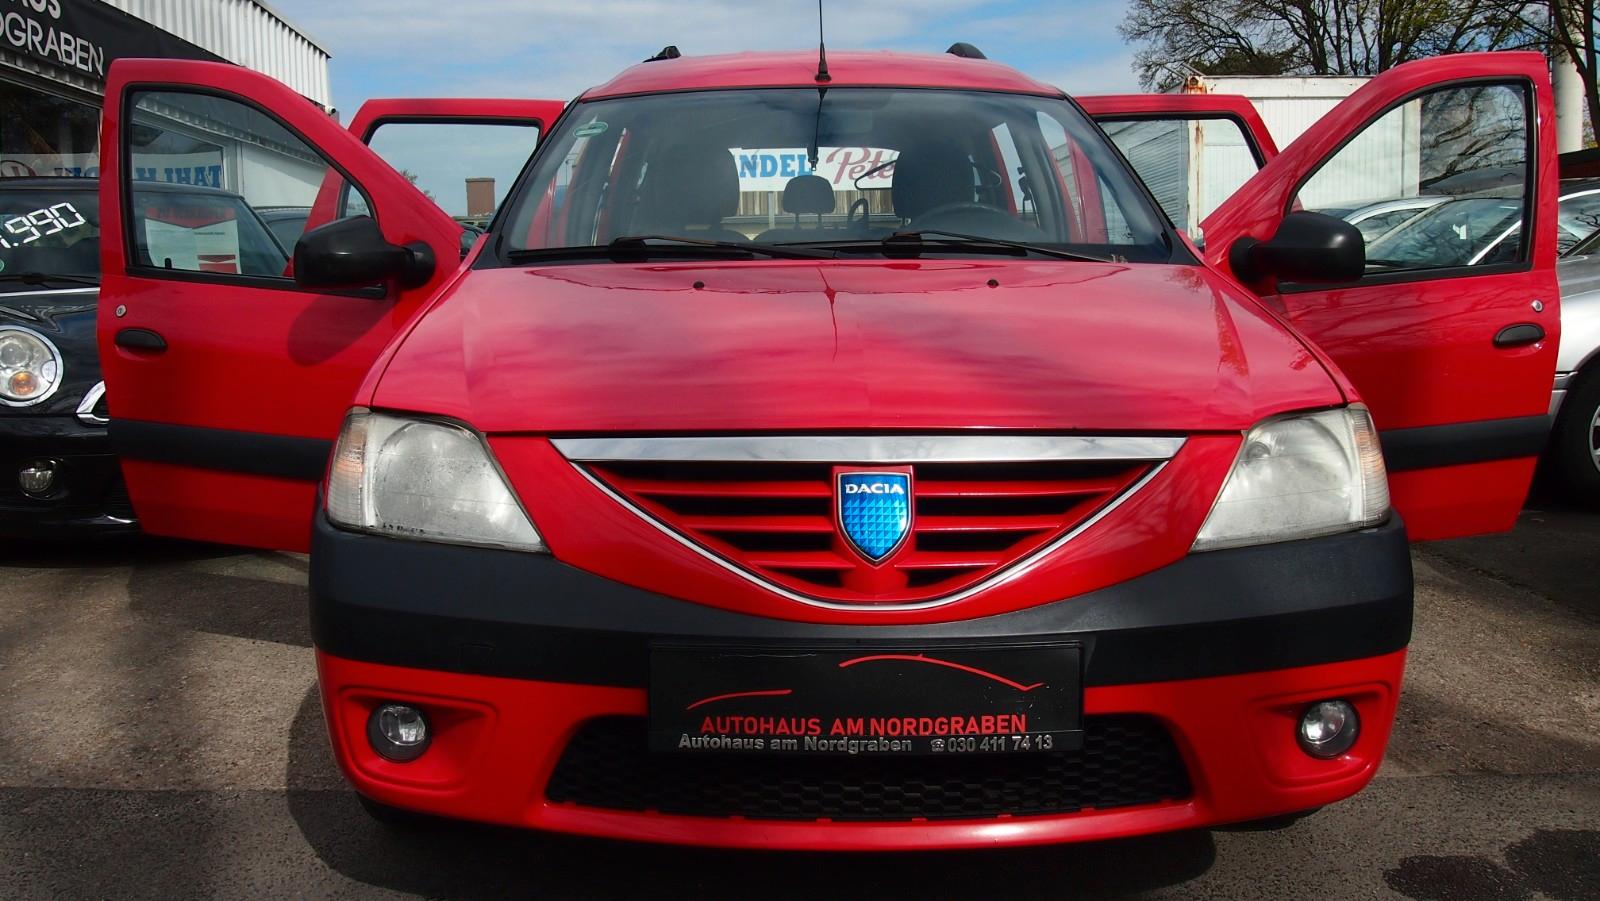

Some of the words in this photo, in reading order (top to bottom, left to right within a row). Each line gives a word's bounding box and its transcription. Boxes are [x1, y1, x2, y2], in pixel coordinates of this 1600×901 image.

[0, 12, 104, 76] GRABEN
[845, 483, 905, 495] DACIA
[701, 715, 822, 736] AUTOHAUS
[830, 717, 864, 736] AM
[870, 714, 1027, 736] NORDGRABEN
[679, 733, 765, 750] Autohaus
[770, 738, 798, 750] am
[804, 736, 912, 754] Nordgraben
[947, 737, 976, 752] 030
[980, 736, 1006, 751] 411
[1011, 735, 1031, 750] 74
[1035, 734, 1053, 749] 13
